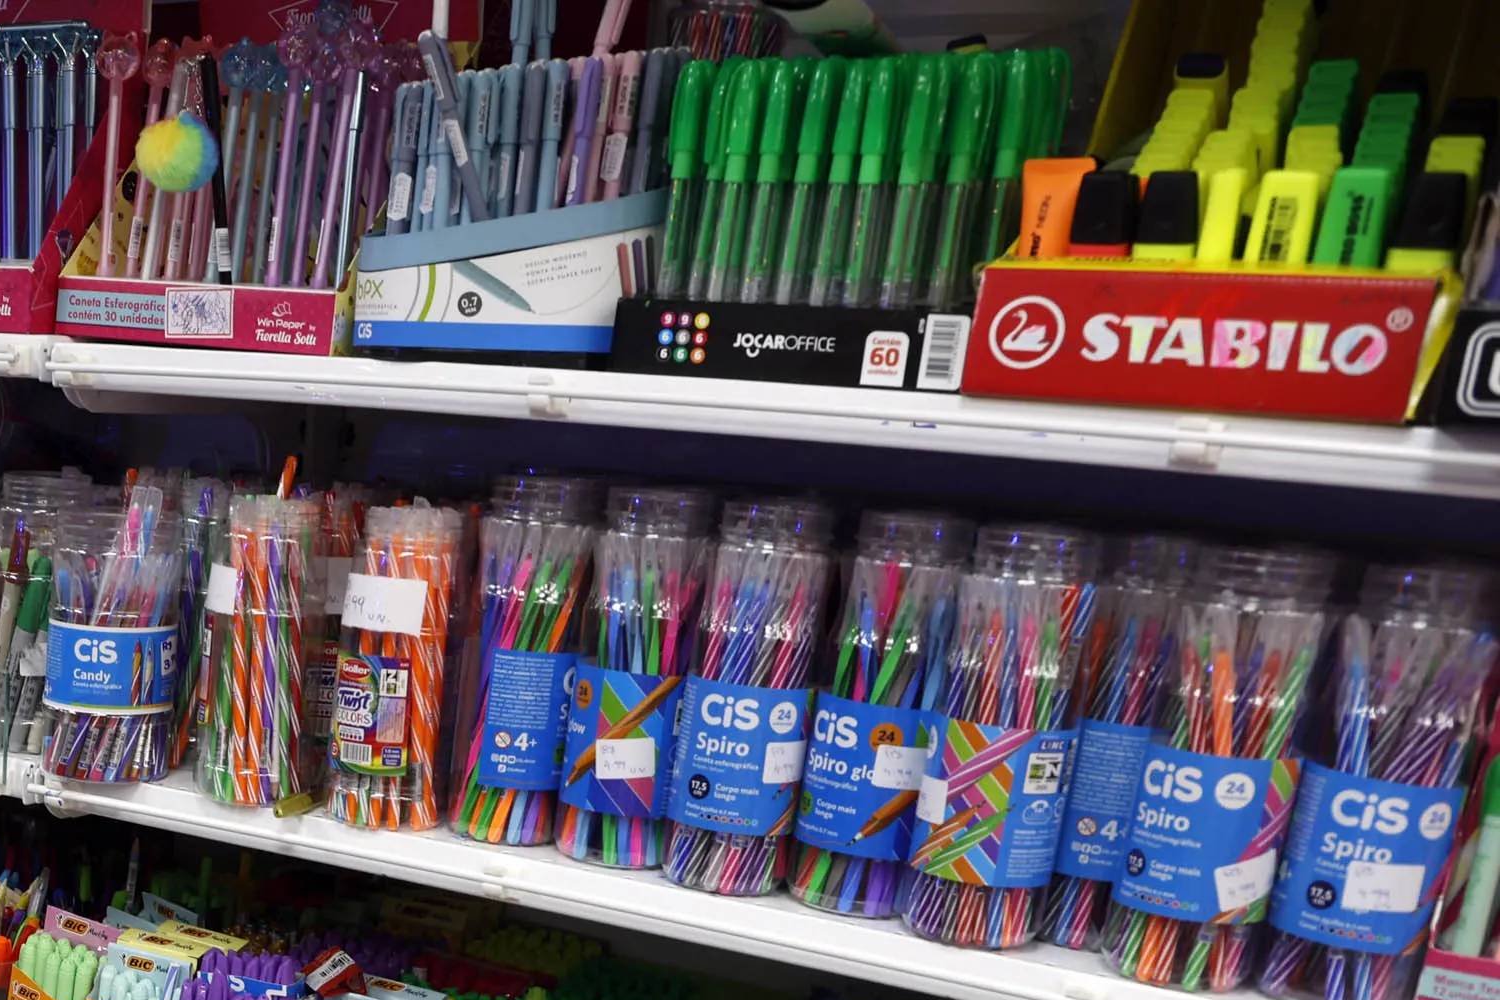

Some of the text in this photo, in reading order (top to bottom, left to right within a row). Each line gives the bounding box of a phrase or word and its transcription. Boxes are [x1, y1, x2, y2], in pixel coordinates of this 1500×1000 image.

[461, 296, 478, 307] 0.7
[68, 310, 165, 326] contém 30 unidades
[733, 333, 836, 353] JOCAROFFICE
[1081, 312, 1388, 376] STABILO
[870, 348, 899, 367] 60
[74, 638, 118, 664] CiS
[73, 668, 111, 684] Candy
[338, 688, 371, 711] Twist
[337, 711, 372, 725] COLORS
[701, 693, 760, 730] CiS
[778, 710, 792, 721] 24
[814, 709, 858, 748] CiS
[878, 730, 895, 742] 24
[514, 732, 537, 752] 4+
[696, 732, 750, 757] Spiro
[715, 783, 760, 796] Corpo mais
[1144, 759, 1203, 803] CiS
[1226, 781, 1246, 794] 24
[1136, 802, 1190, 832] Spiro
[1331, 789, 1410, 835] CiS
[1428, 810, 1446, 825] 24
[1321, 832, 1392, 864] Spiro
[130, 957, 152, 971] BIC
